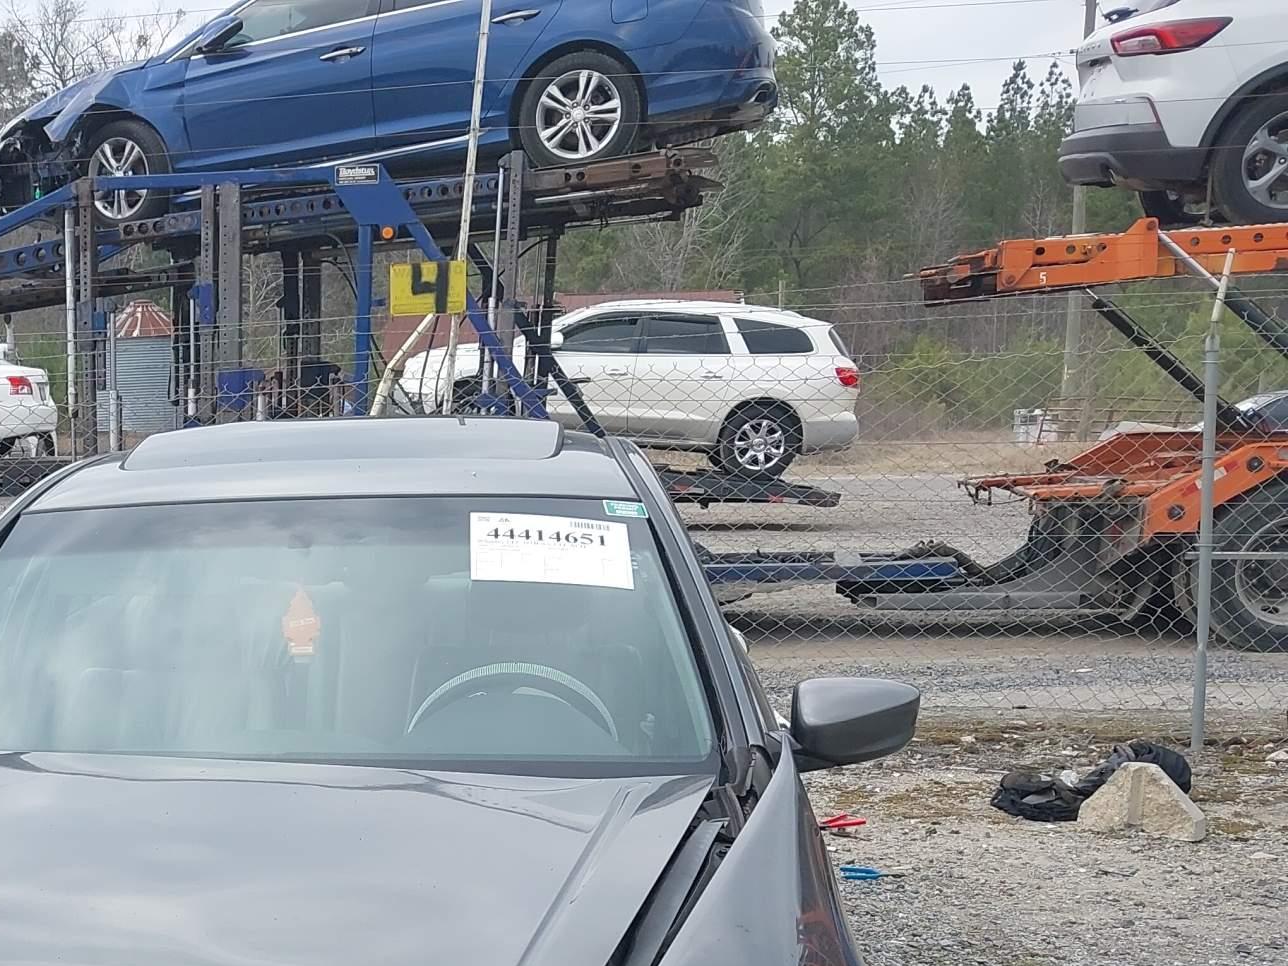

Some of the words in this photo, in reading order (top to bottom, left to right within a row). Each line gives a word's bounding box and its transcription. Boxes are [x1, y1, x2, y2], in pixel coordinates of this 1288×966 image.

[411, 261, 449, 314] 4
[1039, 271, 1047, 285] 5
[486, 527, 607, 547] 44414651
